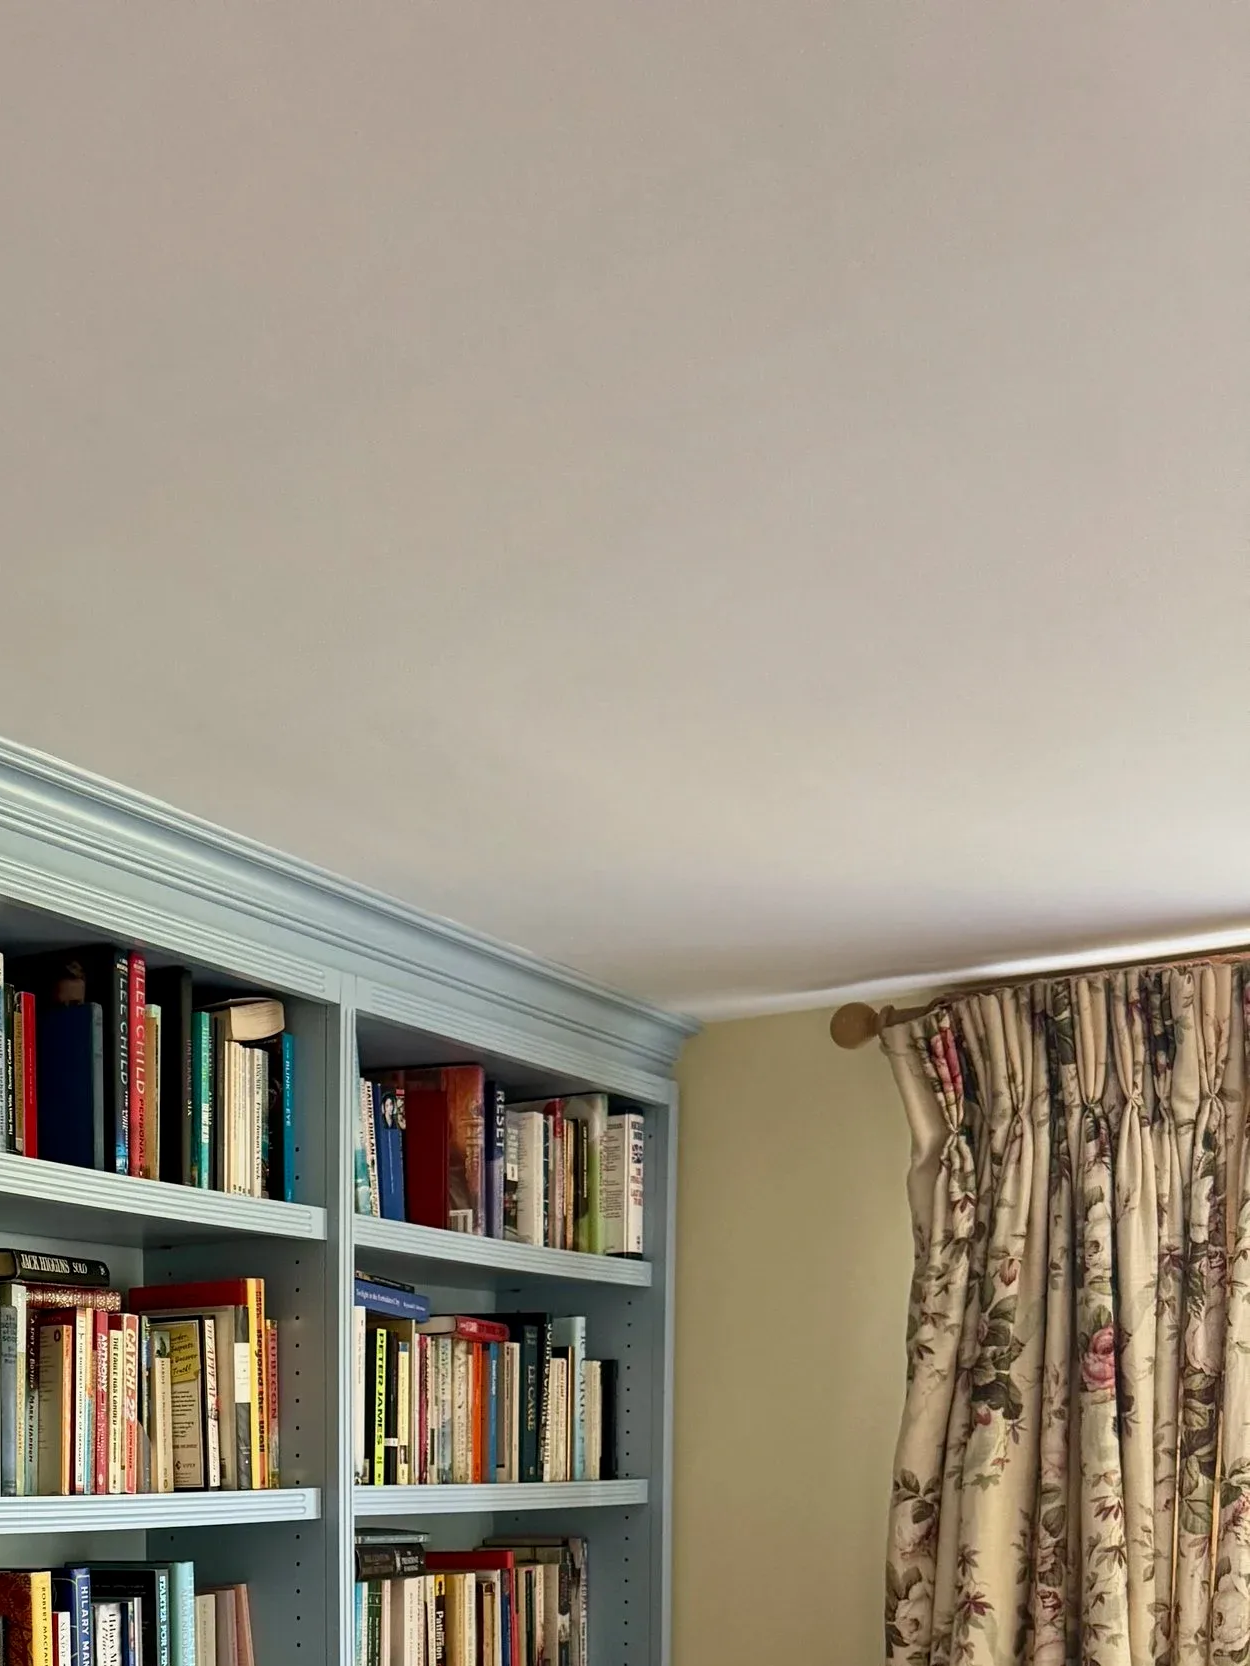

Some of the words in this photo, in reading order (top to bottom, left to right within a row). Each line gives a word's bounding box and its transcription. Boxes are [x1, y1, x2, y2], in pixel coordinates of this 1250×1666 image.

[136, 977, 145, 1018] LEE
[136, 1025, 145, 1094] CHILD
[126, 1329, 135, 1421] CATCH-22
[435, 1610, 444, 1659] Patterson
